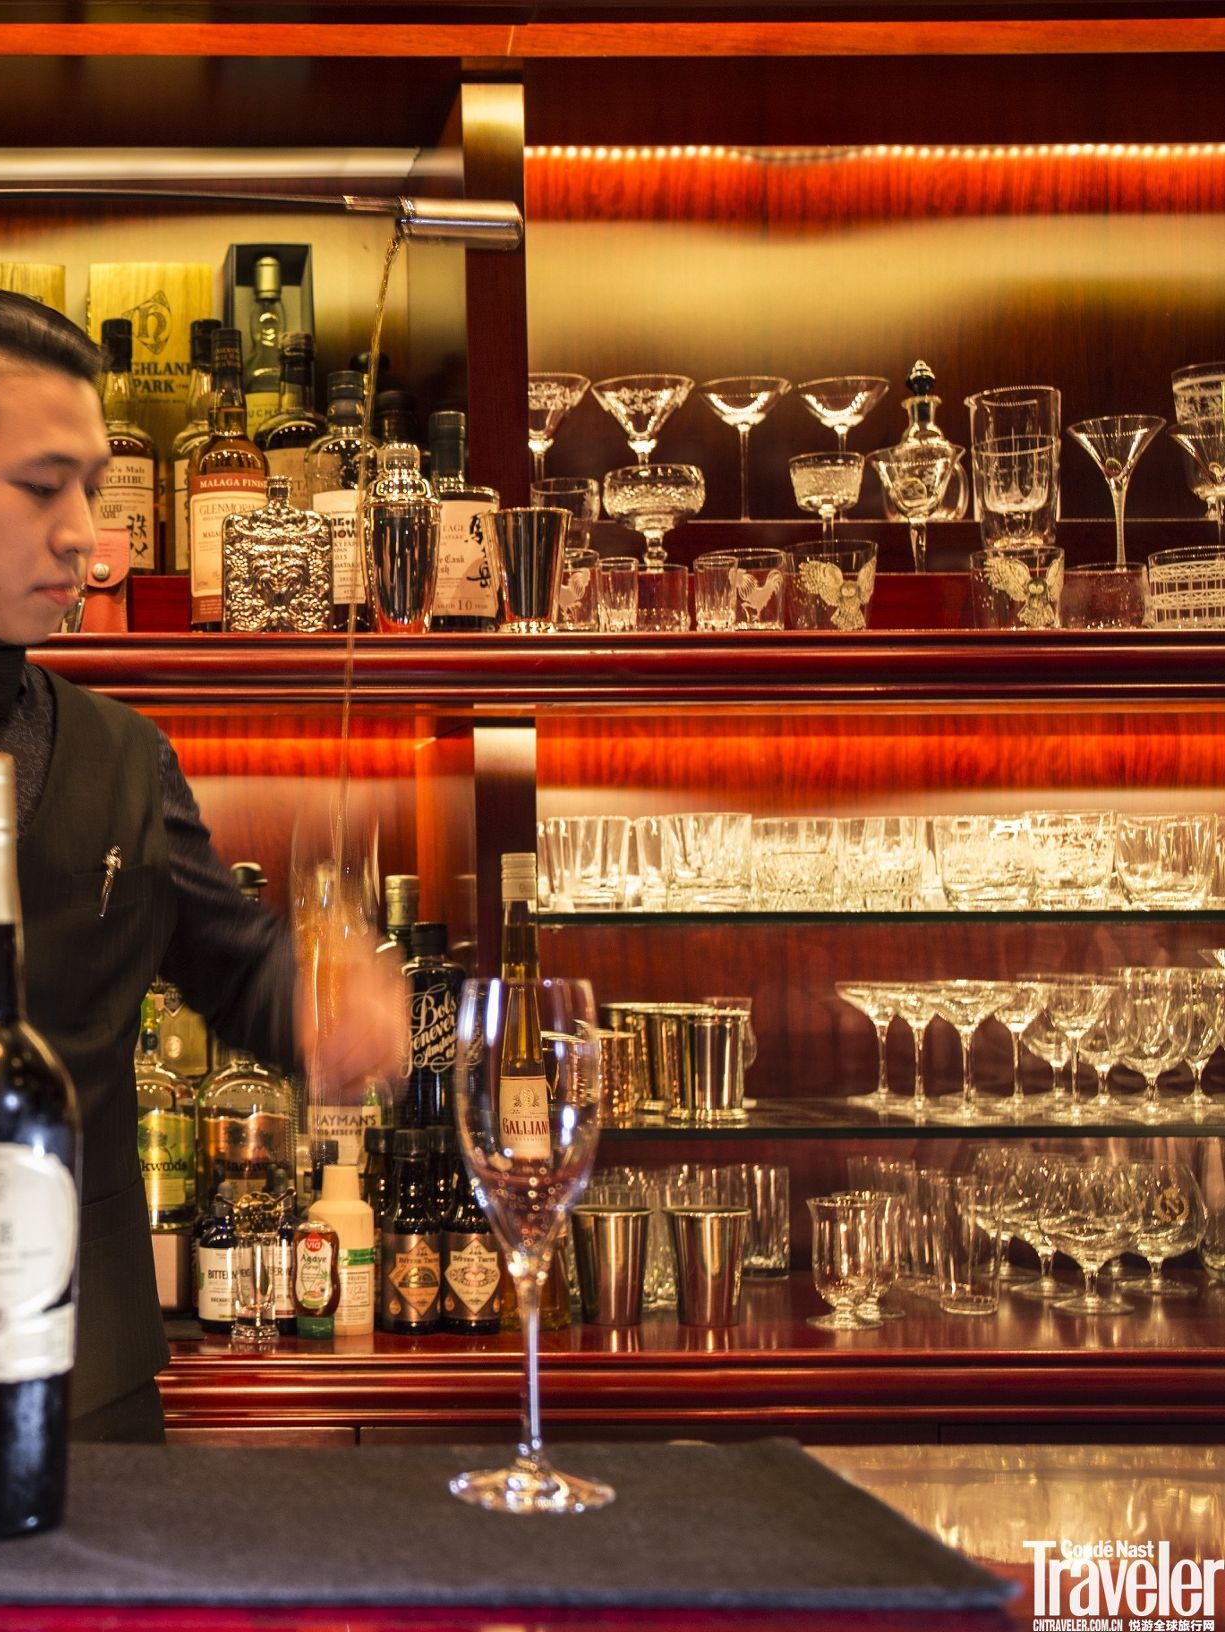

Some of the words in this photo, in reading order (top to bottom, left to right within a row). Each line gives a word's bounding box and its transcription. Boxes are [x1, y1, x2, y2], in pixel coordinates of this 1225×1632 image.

[132, 362, 191, 376] GHLAN
[133, 379, 175, 393] PARK
[106, 475, 145, 485] ICHIBU
[200, 478, 240, 489] MALAGA
[242, 478, 268, 488] FINIS
[502, 1117, 549, 1135] GALLIAN
[301, 1254, 327, 1264] Agave
